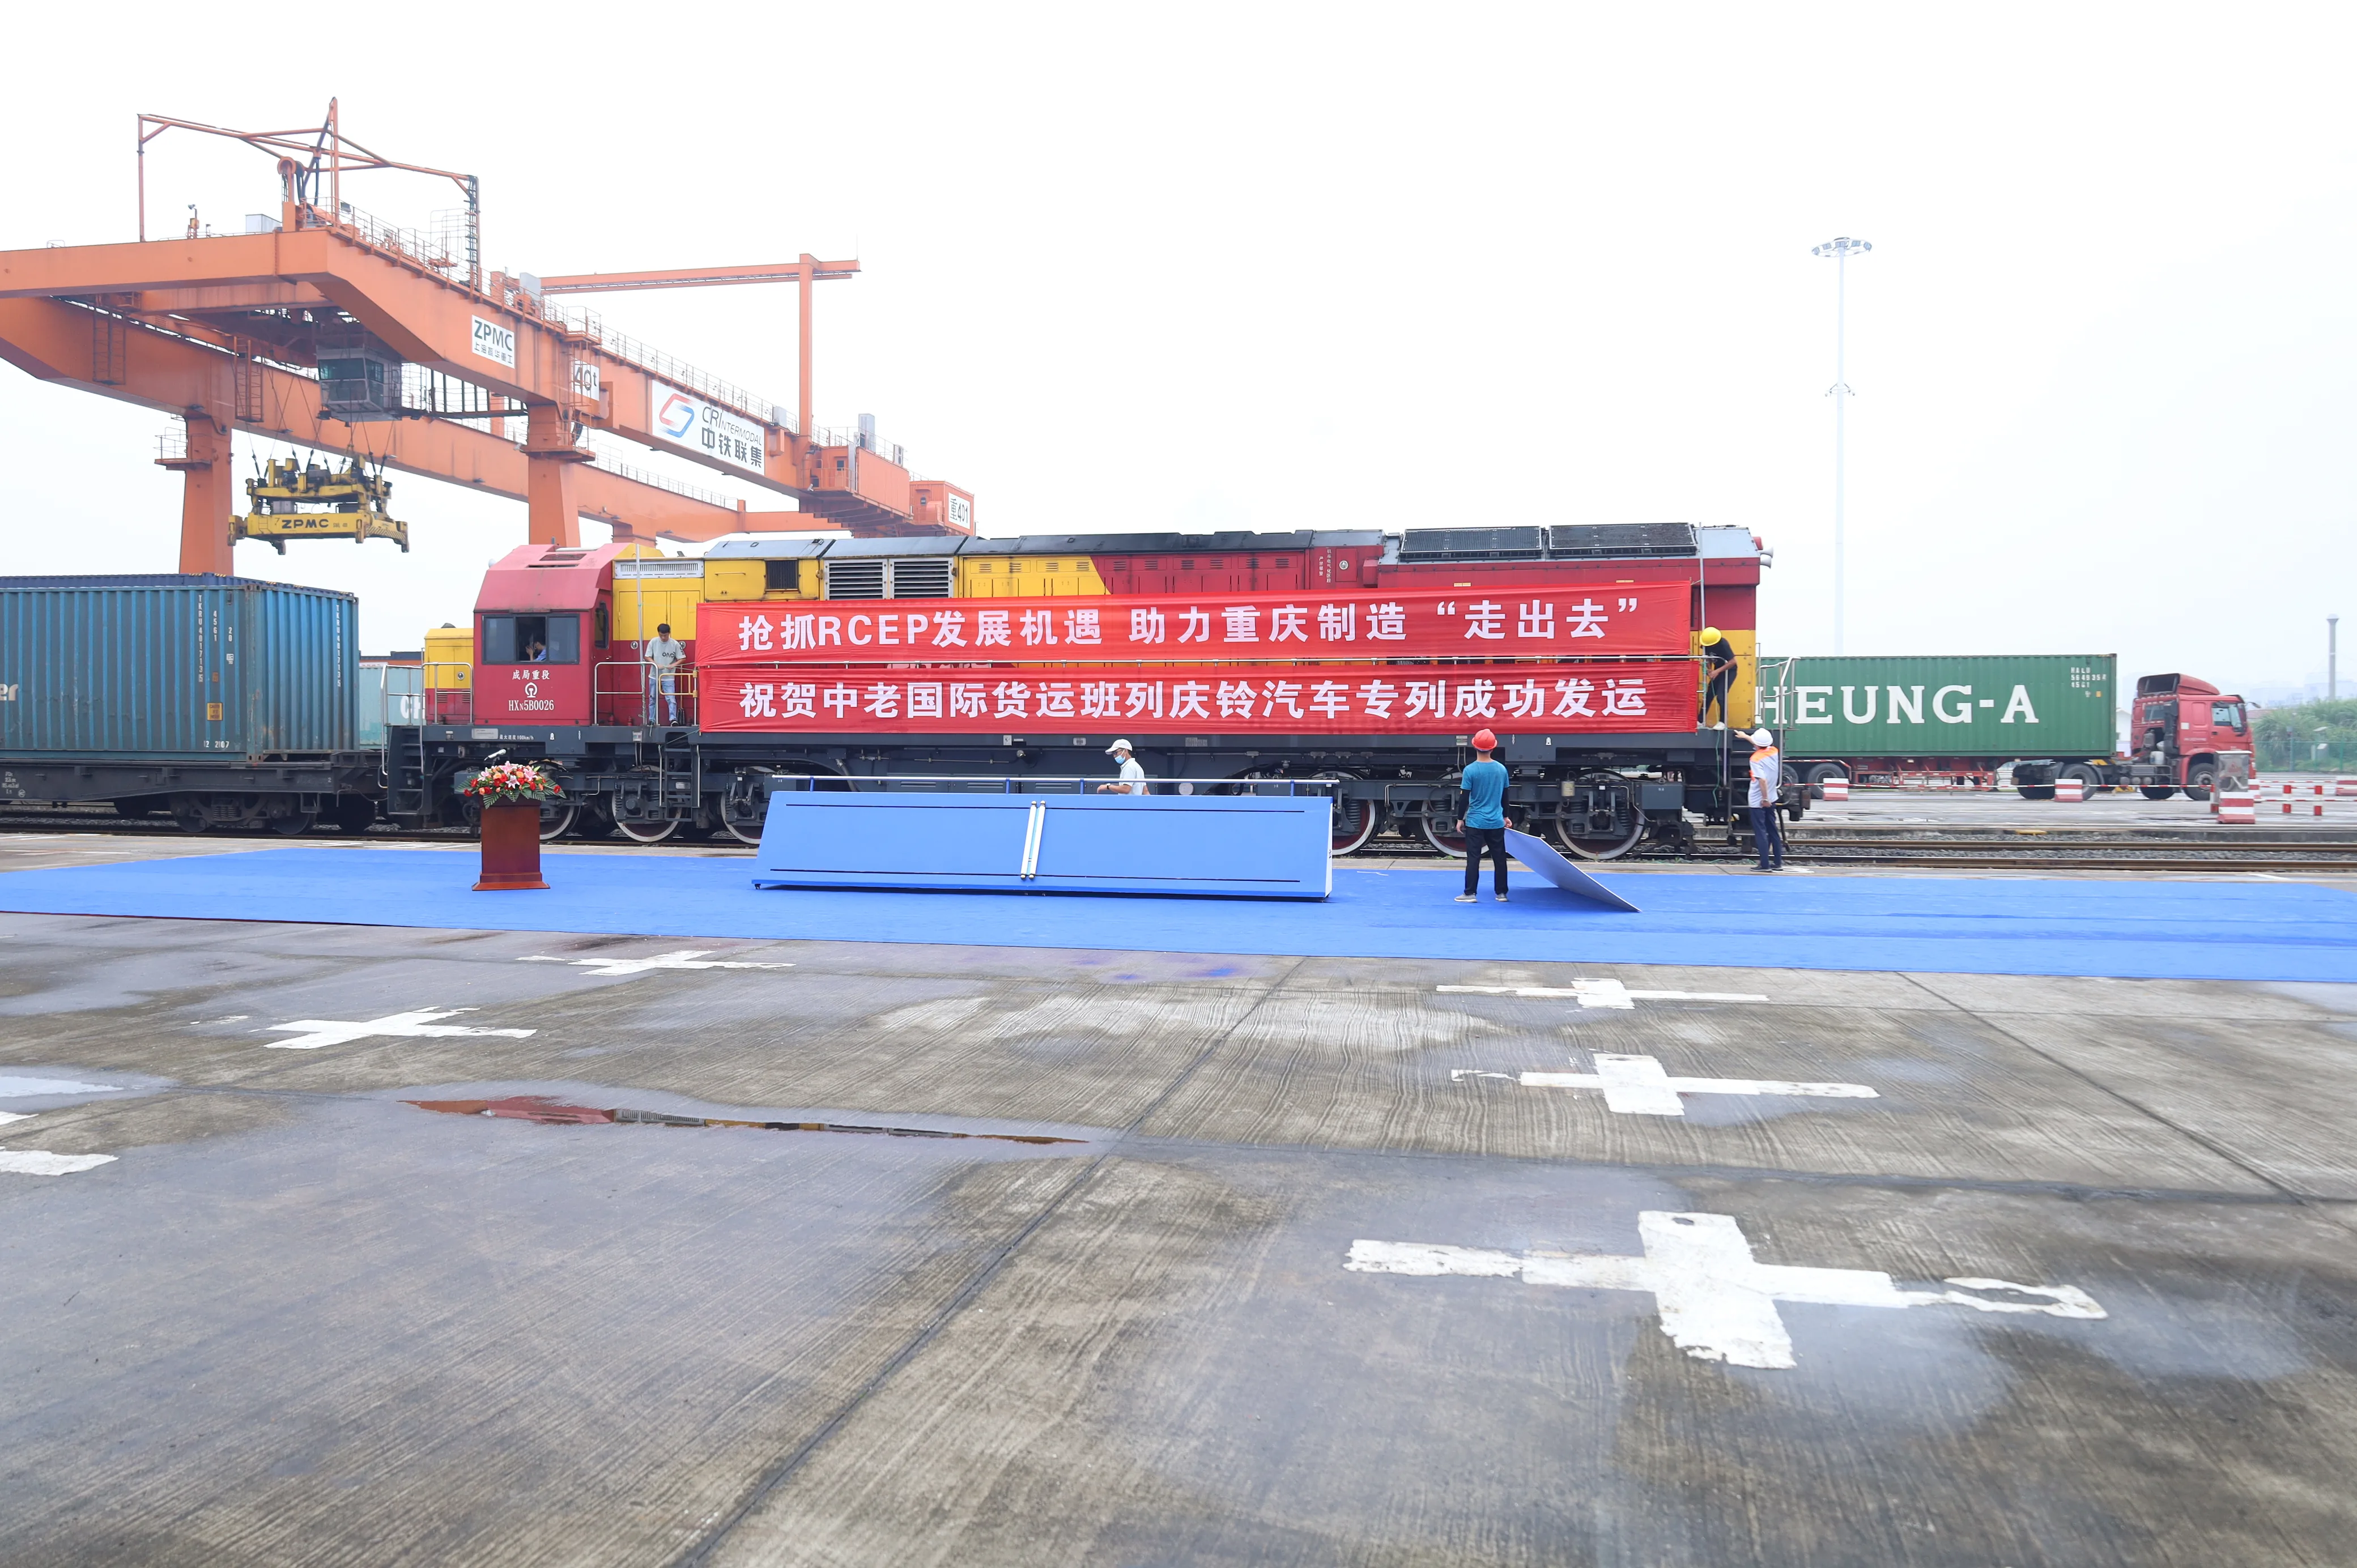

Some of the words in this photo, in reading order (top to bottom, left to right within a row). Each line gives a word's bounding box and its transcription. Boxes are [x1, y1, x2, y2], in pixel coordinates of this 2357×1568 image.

[474, 319, 513, 351] ZPMC
[701, 427, 762, 468] 中铁联集
[282, 519, 329, 529] ZPMC
[950, 498, 968, 523] 重401
[738, 608, 1103, 651] 抢抓RCEP发展机遇
[512, 669, 550, 680] 成局重段
[739, 678, 1648, 719] 祝贺中老国际货运班列庆铃汽车专列成功发运
